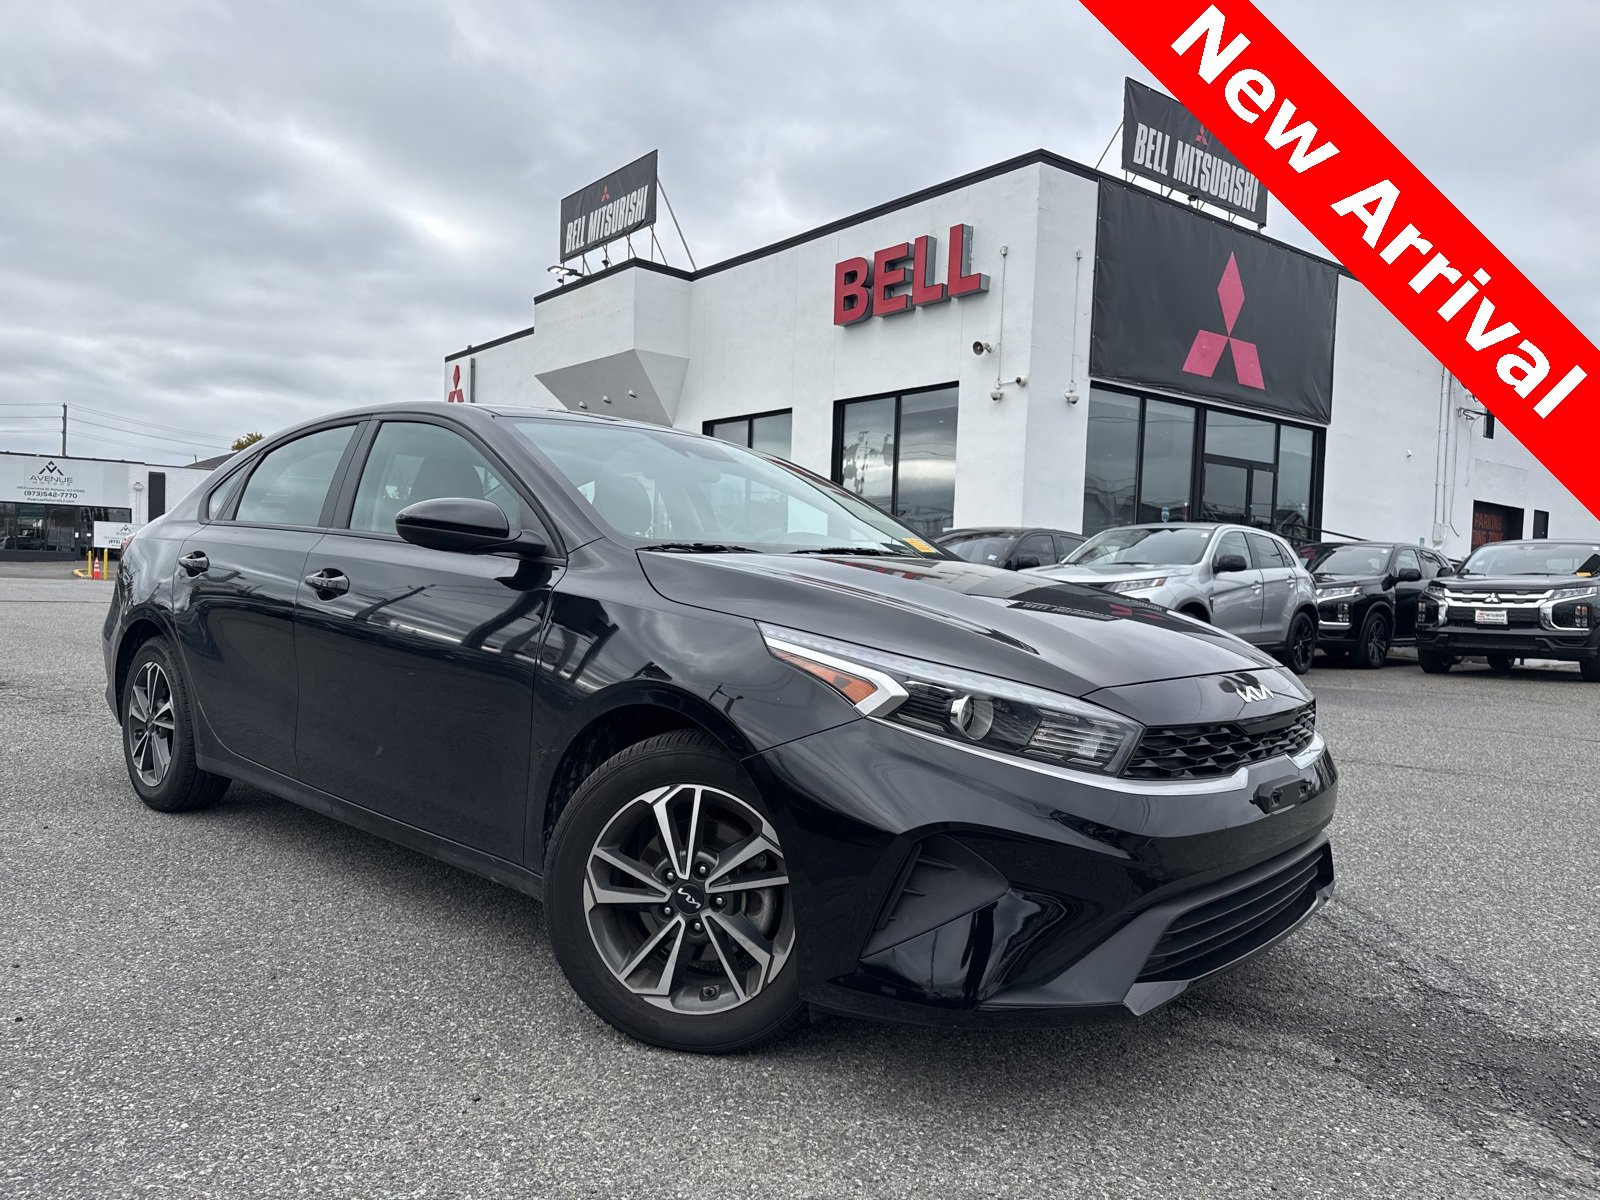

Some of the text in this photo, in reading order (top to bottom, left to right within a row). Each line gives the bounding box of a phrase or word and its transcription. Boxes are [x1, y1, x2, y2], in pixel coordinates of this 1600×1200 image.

[1133, 122, 1259, 213] BELL MITSUBISHI
[565, 184, 649, 254] BELL MITSUBISHI
[834, 223, 989, 326] BELL
[30, 475, 73, 483] AVENUE
